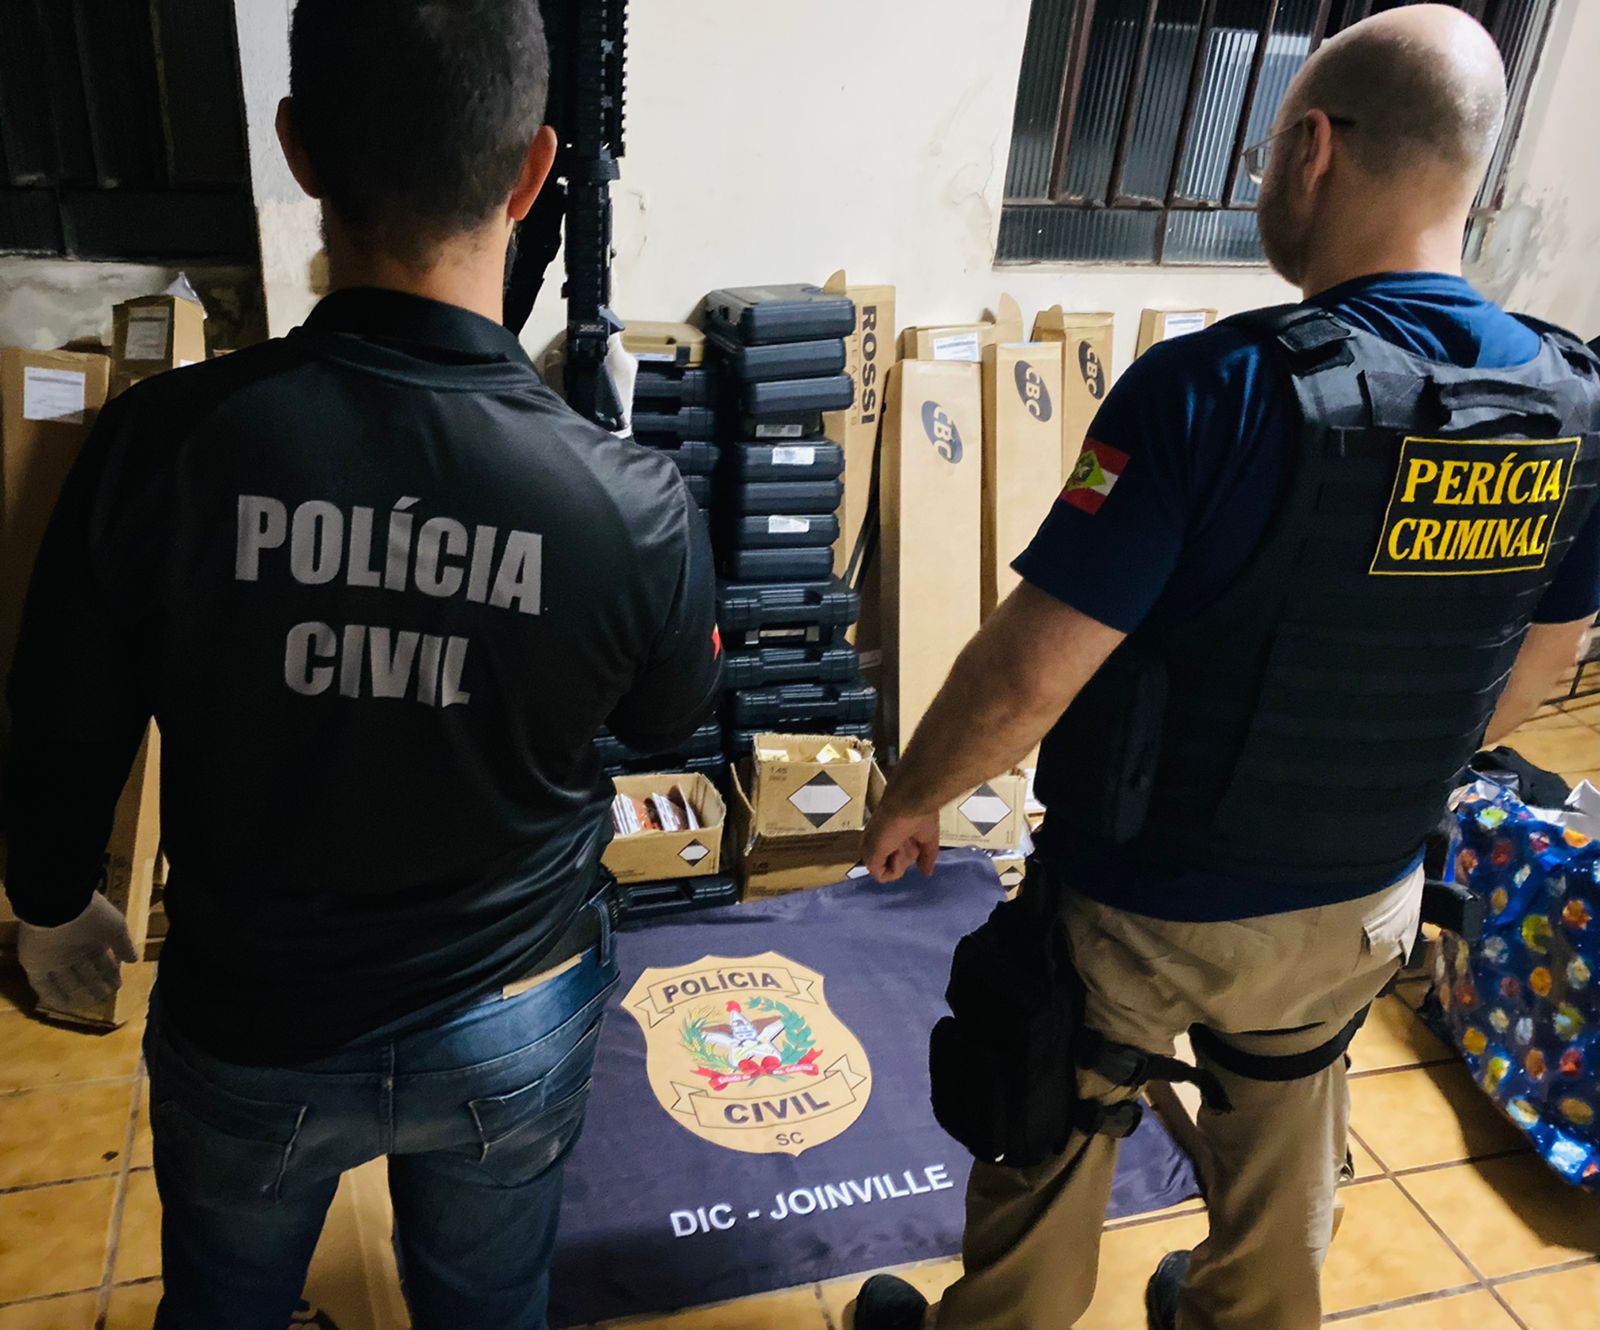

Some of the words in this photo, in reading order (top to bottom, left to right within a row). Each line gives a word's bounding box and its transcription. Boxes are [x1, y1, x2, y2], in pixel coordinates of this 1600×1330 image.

[861, 305, 877, 425] ROSSI
[1086, 346, 1099, 395] CBC
[1025, 367, 1041, 417] CBC
[933, 405, 953, 460] CBC
[1400, 452, 1564, 505] PERÍCIA
[235, 494, 543, 616] POLÍCIA
[1387, 514, 1549, 561] CRIMINAL
[284, 621, 471, 708] CIVIL
[662, 970, 783, 1004] POLÍCIA
[723, 1091, 831, 1124] CIVIL
[775, 1131, 804, 1146] SC
[669, 1202, 737, 1238] DIC
[747, 1208, 761, 1219] -
[769, 1164, 954, 1221] JOINVILLE
